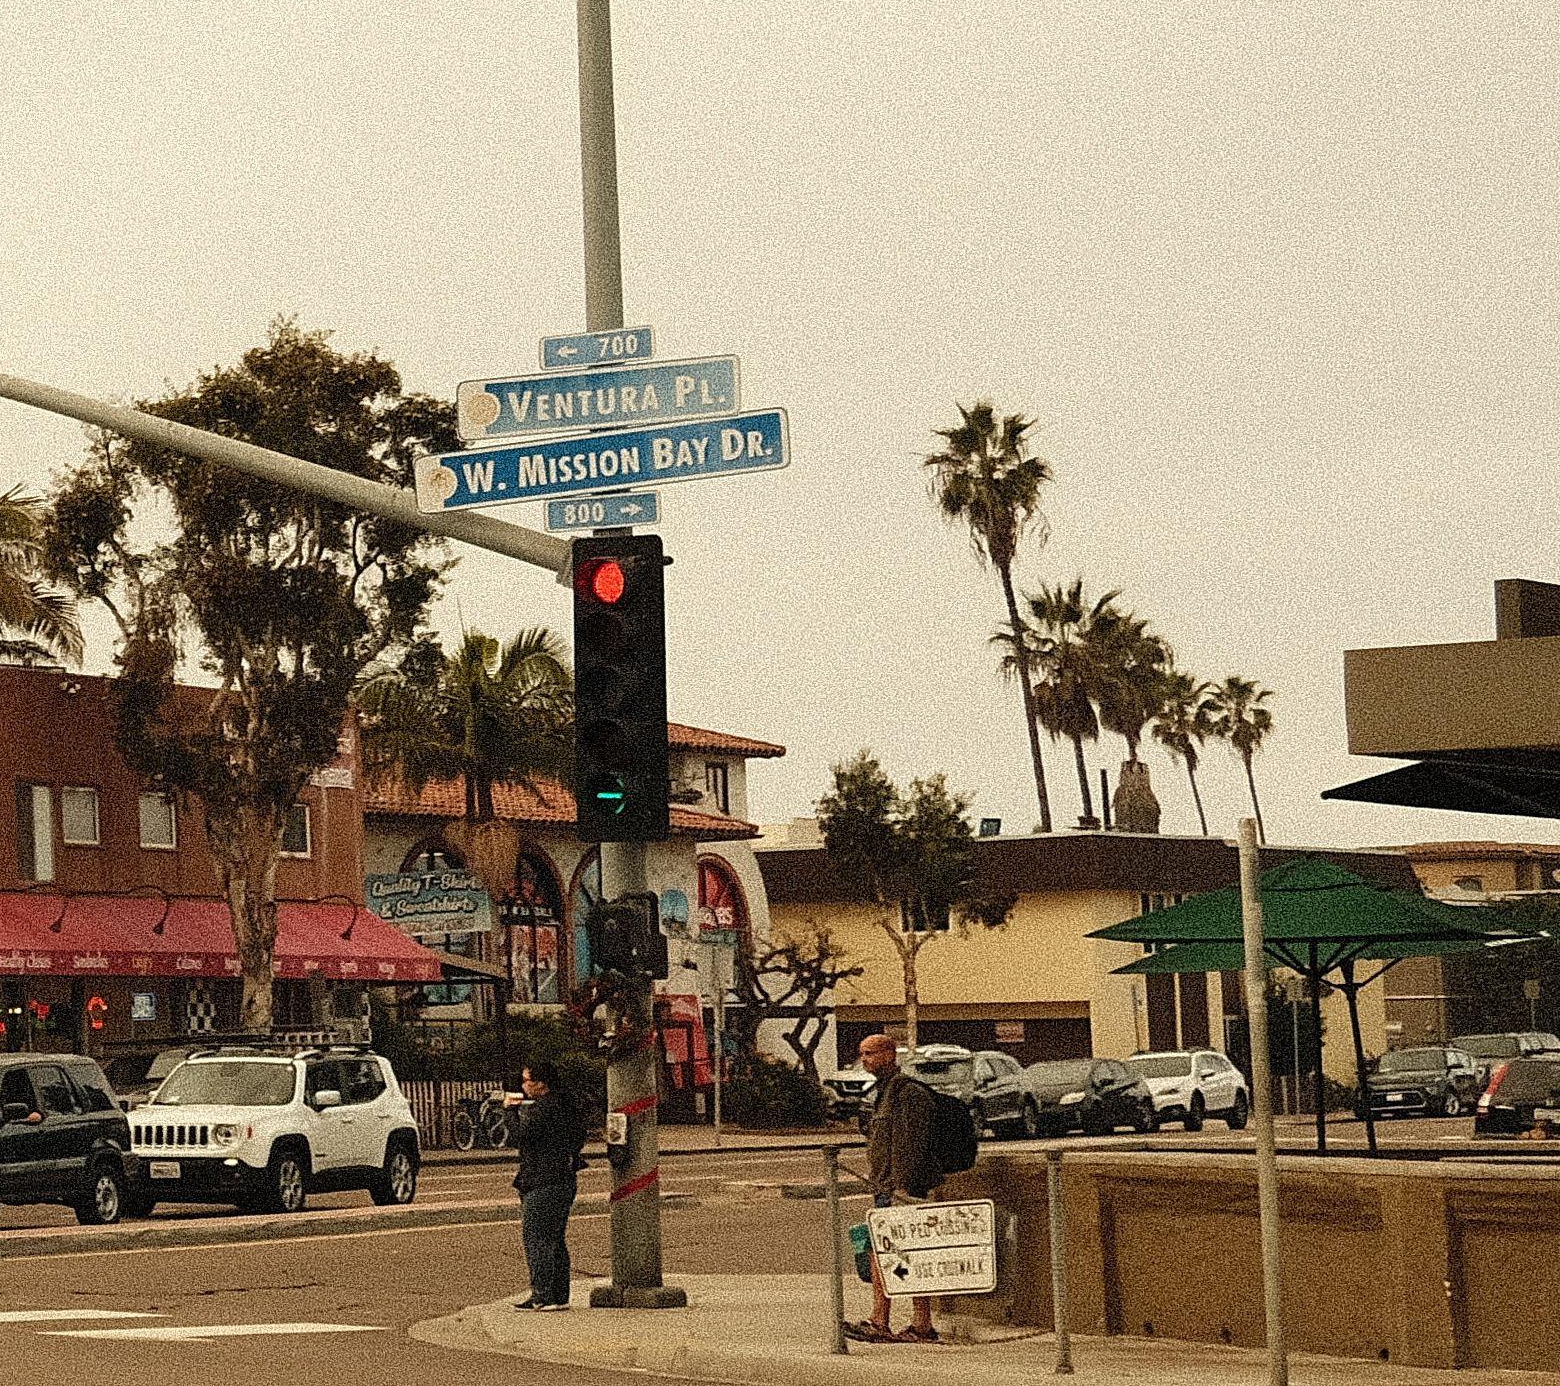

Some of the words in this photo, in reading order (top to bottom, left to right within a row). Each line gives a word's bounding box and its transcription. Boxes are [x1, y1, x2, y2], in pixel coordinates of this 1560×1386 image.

[597, 334, 639, 358] 700
[507, 382, 660, 424] VENTURA
[462, 459, 506, 495] W.
[519, 446, 641, 489] MISSION
[651, 433, 709, 471] BAY
[720, 428, 773, 461] DR.
[564, 501, 605, 524] 800
[372, 876, 421, 897] Quality
[890, 1224, 906, 1240] NO
